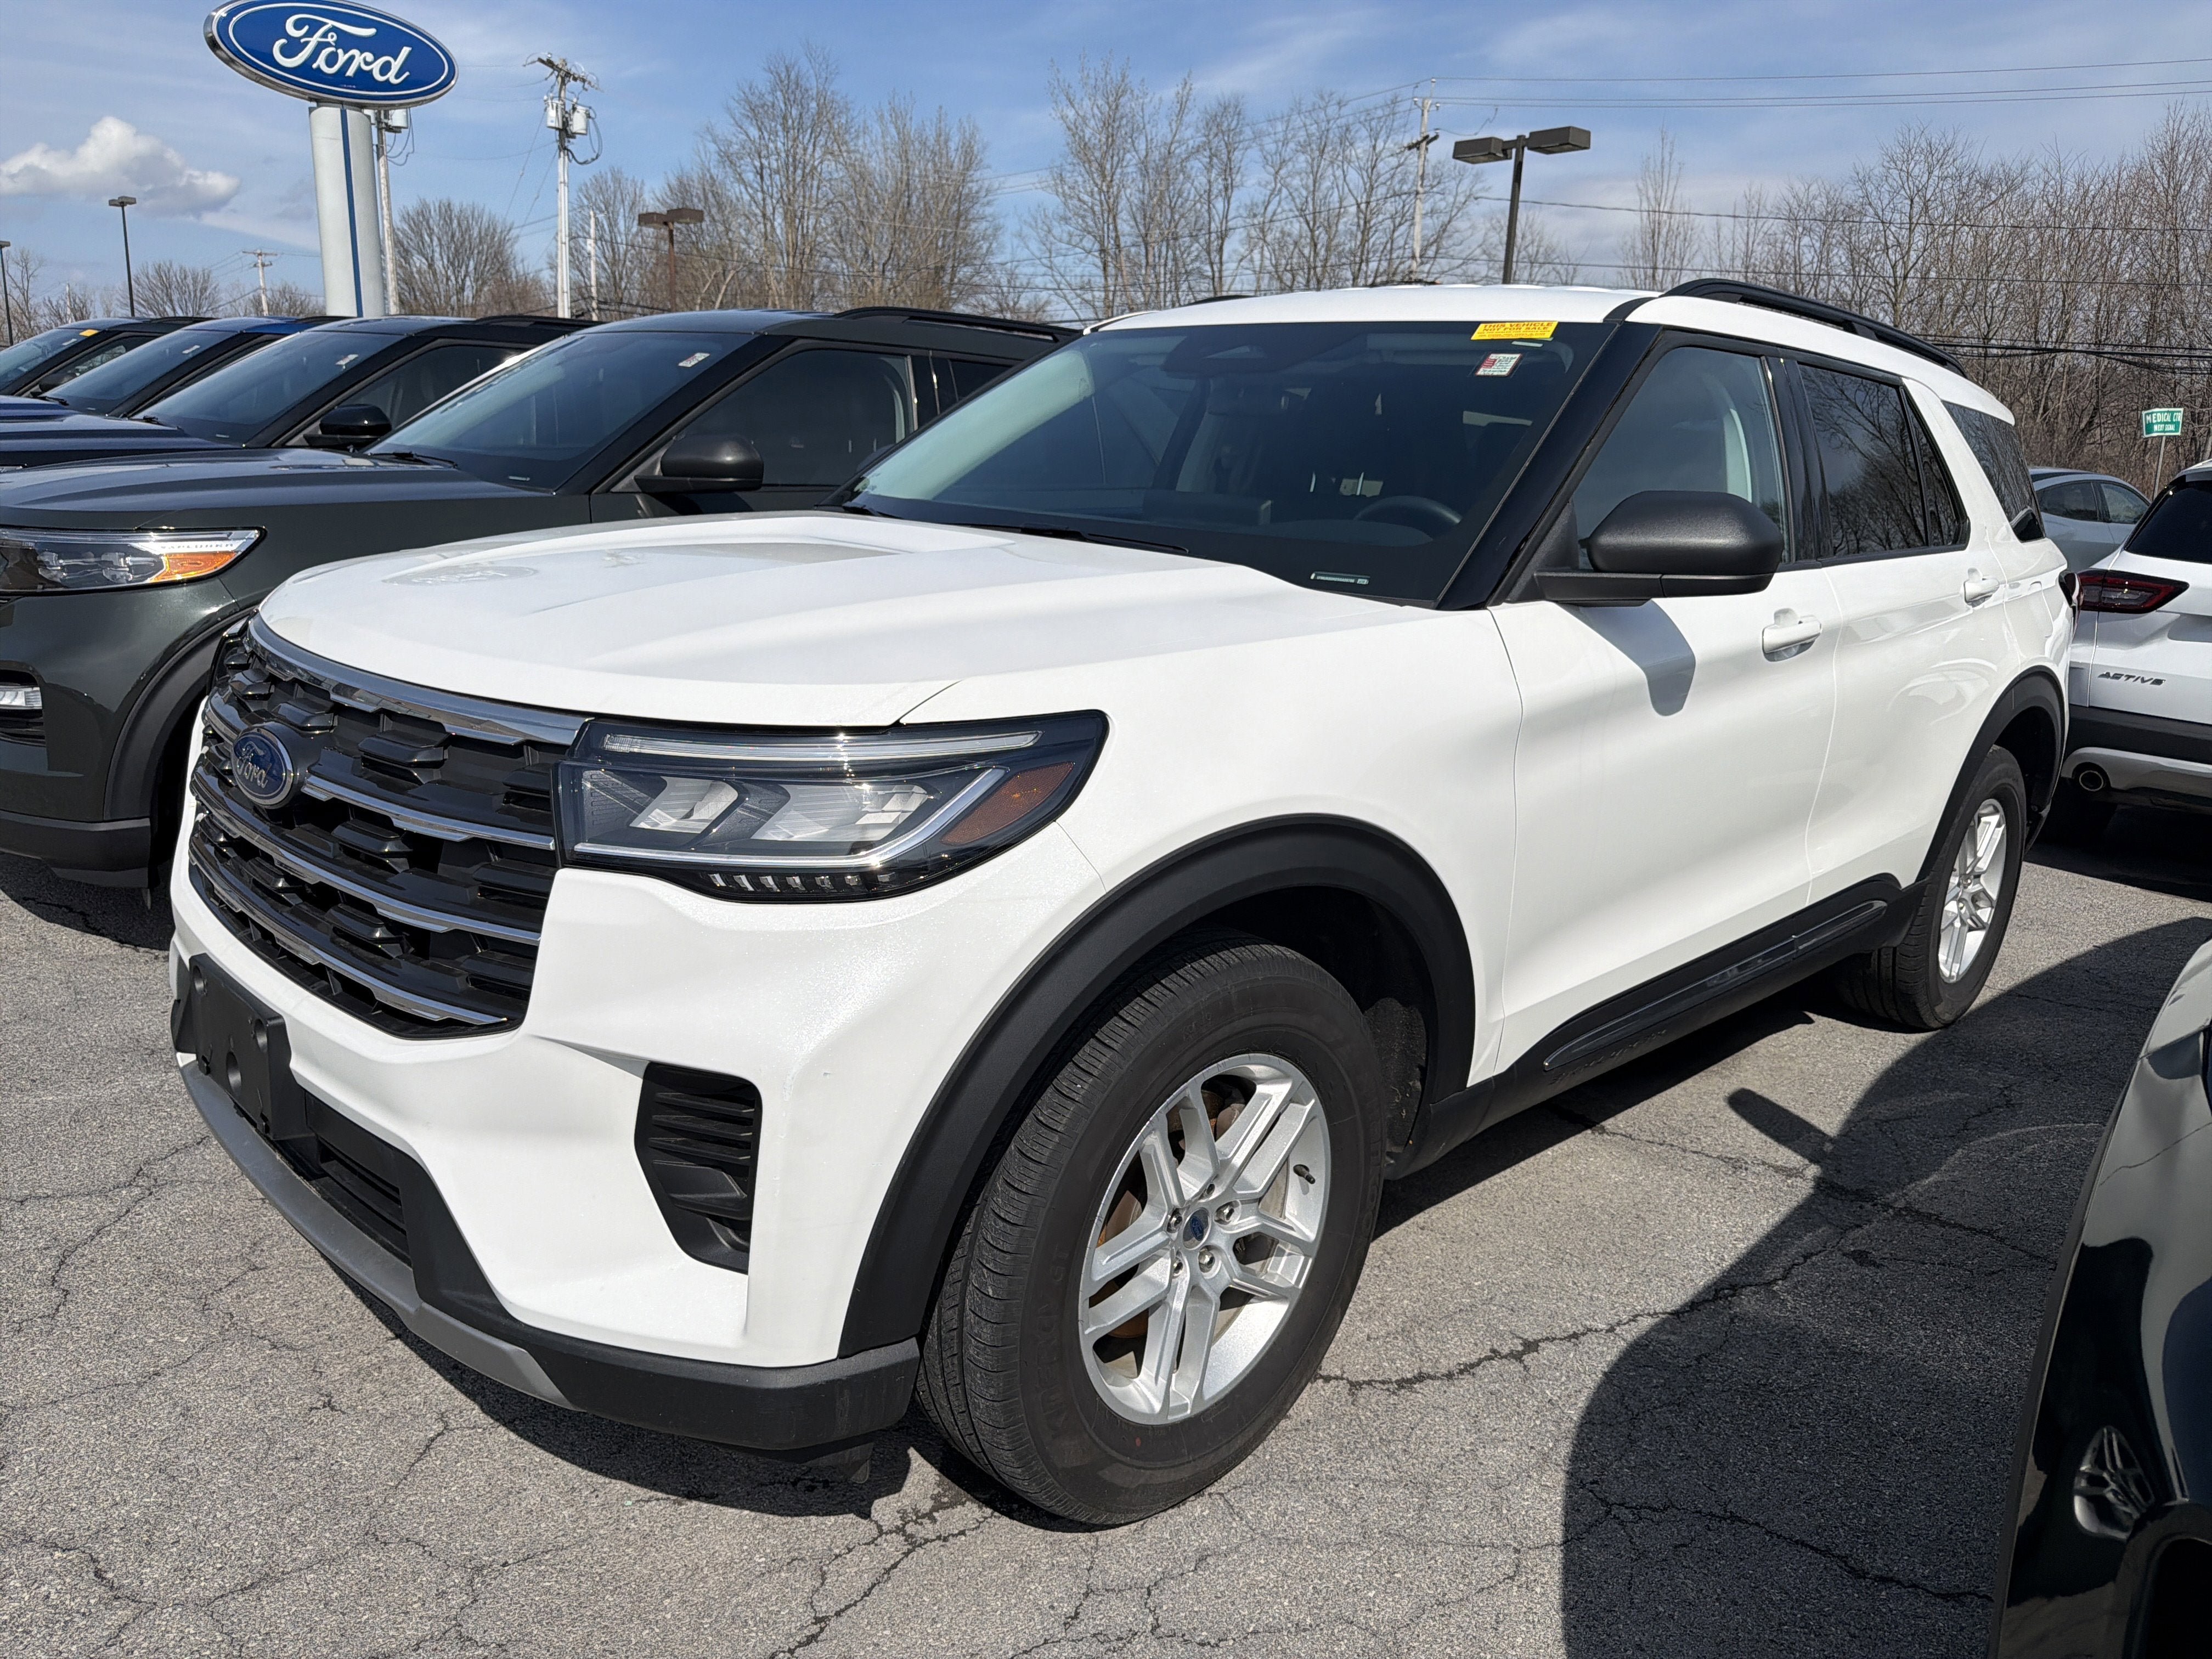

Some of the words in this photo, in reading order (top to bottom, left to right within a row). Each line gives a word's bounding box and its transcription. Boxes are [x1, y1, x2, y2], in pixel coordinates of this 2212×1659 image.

[273, 14, 412, 85] Ford
[2146, 412, 2171, 425] MEDICAL
[2172, 412, 2181, 422] CTR
[2154, 424, 2165, 432] NEXT
[2098, 672, 2166, 686] ACTIVE
[236, 741, 272, 789] Ford
